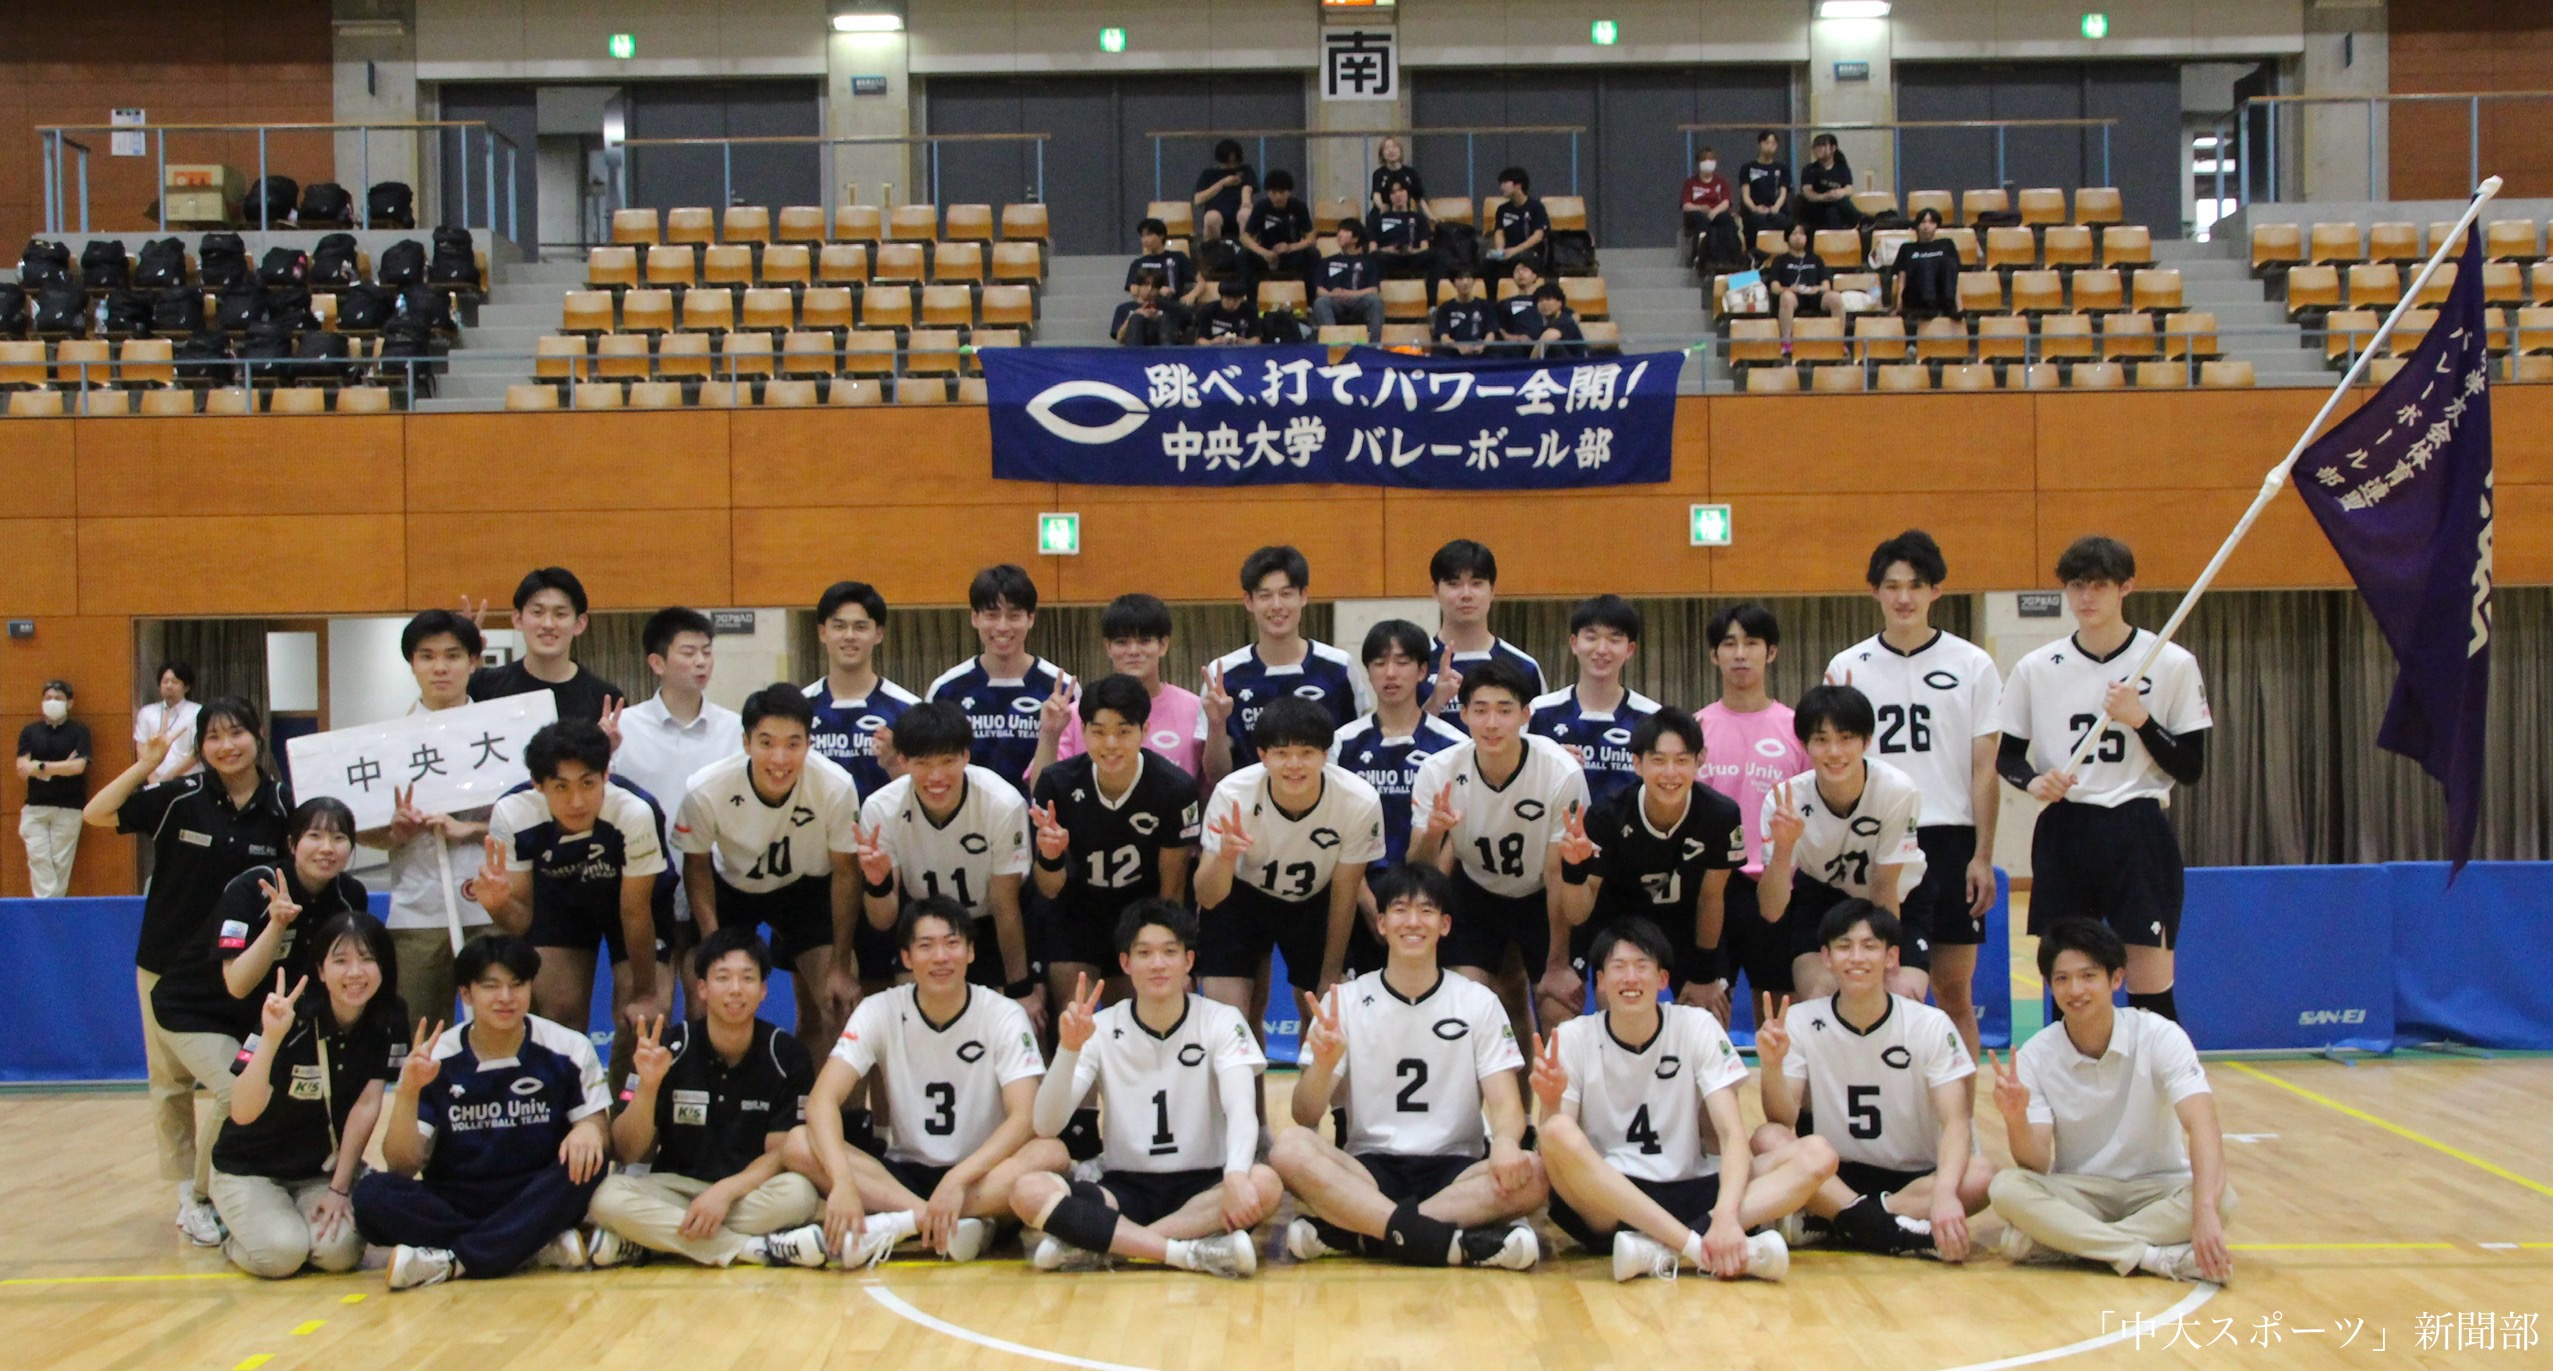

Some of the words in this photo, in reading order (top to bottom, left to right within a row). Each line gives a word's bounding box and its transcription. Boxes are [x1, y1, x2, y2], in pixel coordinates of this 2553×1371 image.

[1326, 31, 1392, 95] 南
[1161, 415, 1327, 473] 中央大学
[1345, 426, 1615, 471] バレーボール部
[1878, 703, 1931, 754] 26
[2069, 713, 2126, 764] 25
[346, 731, 509, 793] 中央大
[746, 835, 792, 880] 10
[1086, 843, 1142, 888] 12
[1259, 860, 1316, 896] 13
[1474, 832, 1524, 878] 18
[922, 866, 977, 909] 11
[448, 1101, 502, 1122] CHUO
[507, 1098, 551, 1118] Univ.
[924, 1081, 956, 1136] 3
[1396, 1057, 1429, 1113] 2
[451, 1118, 517, 1132] VOLLEYBALL
[520, 1114, 550, 1125] TEAM
[1151, 1088, 1175, 1146] 1
[1625, 1102, 1663, 1155] 4
[1847, 1085, 1883, 1140] 5
